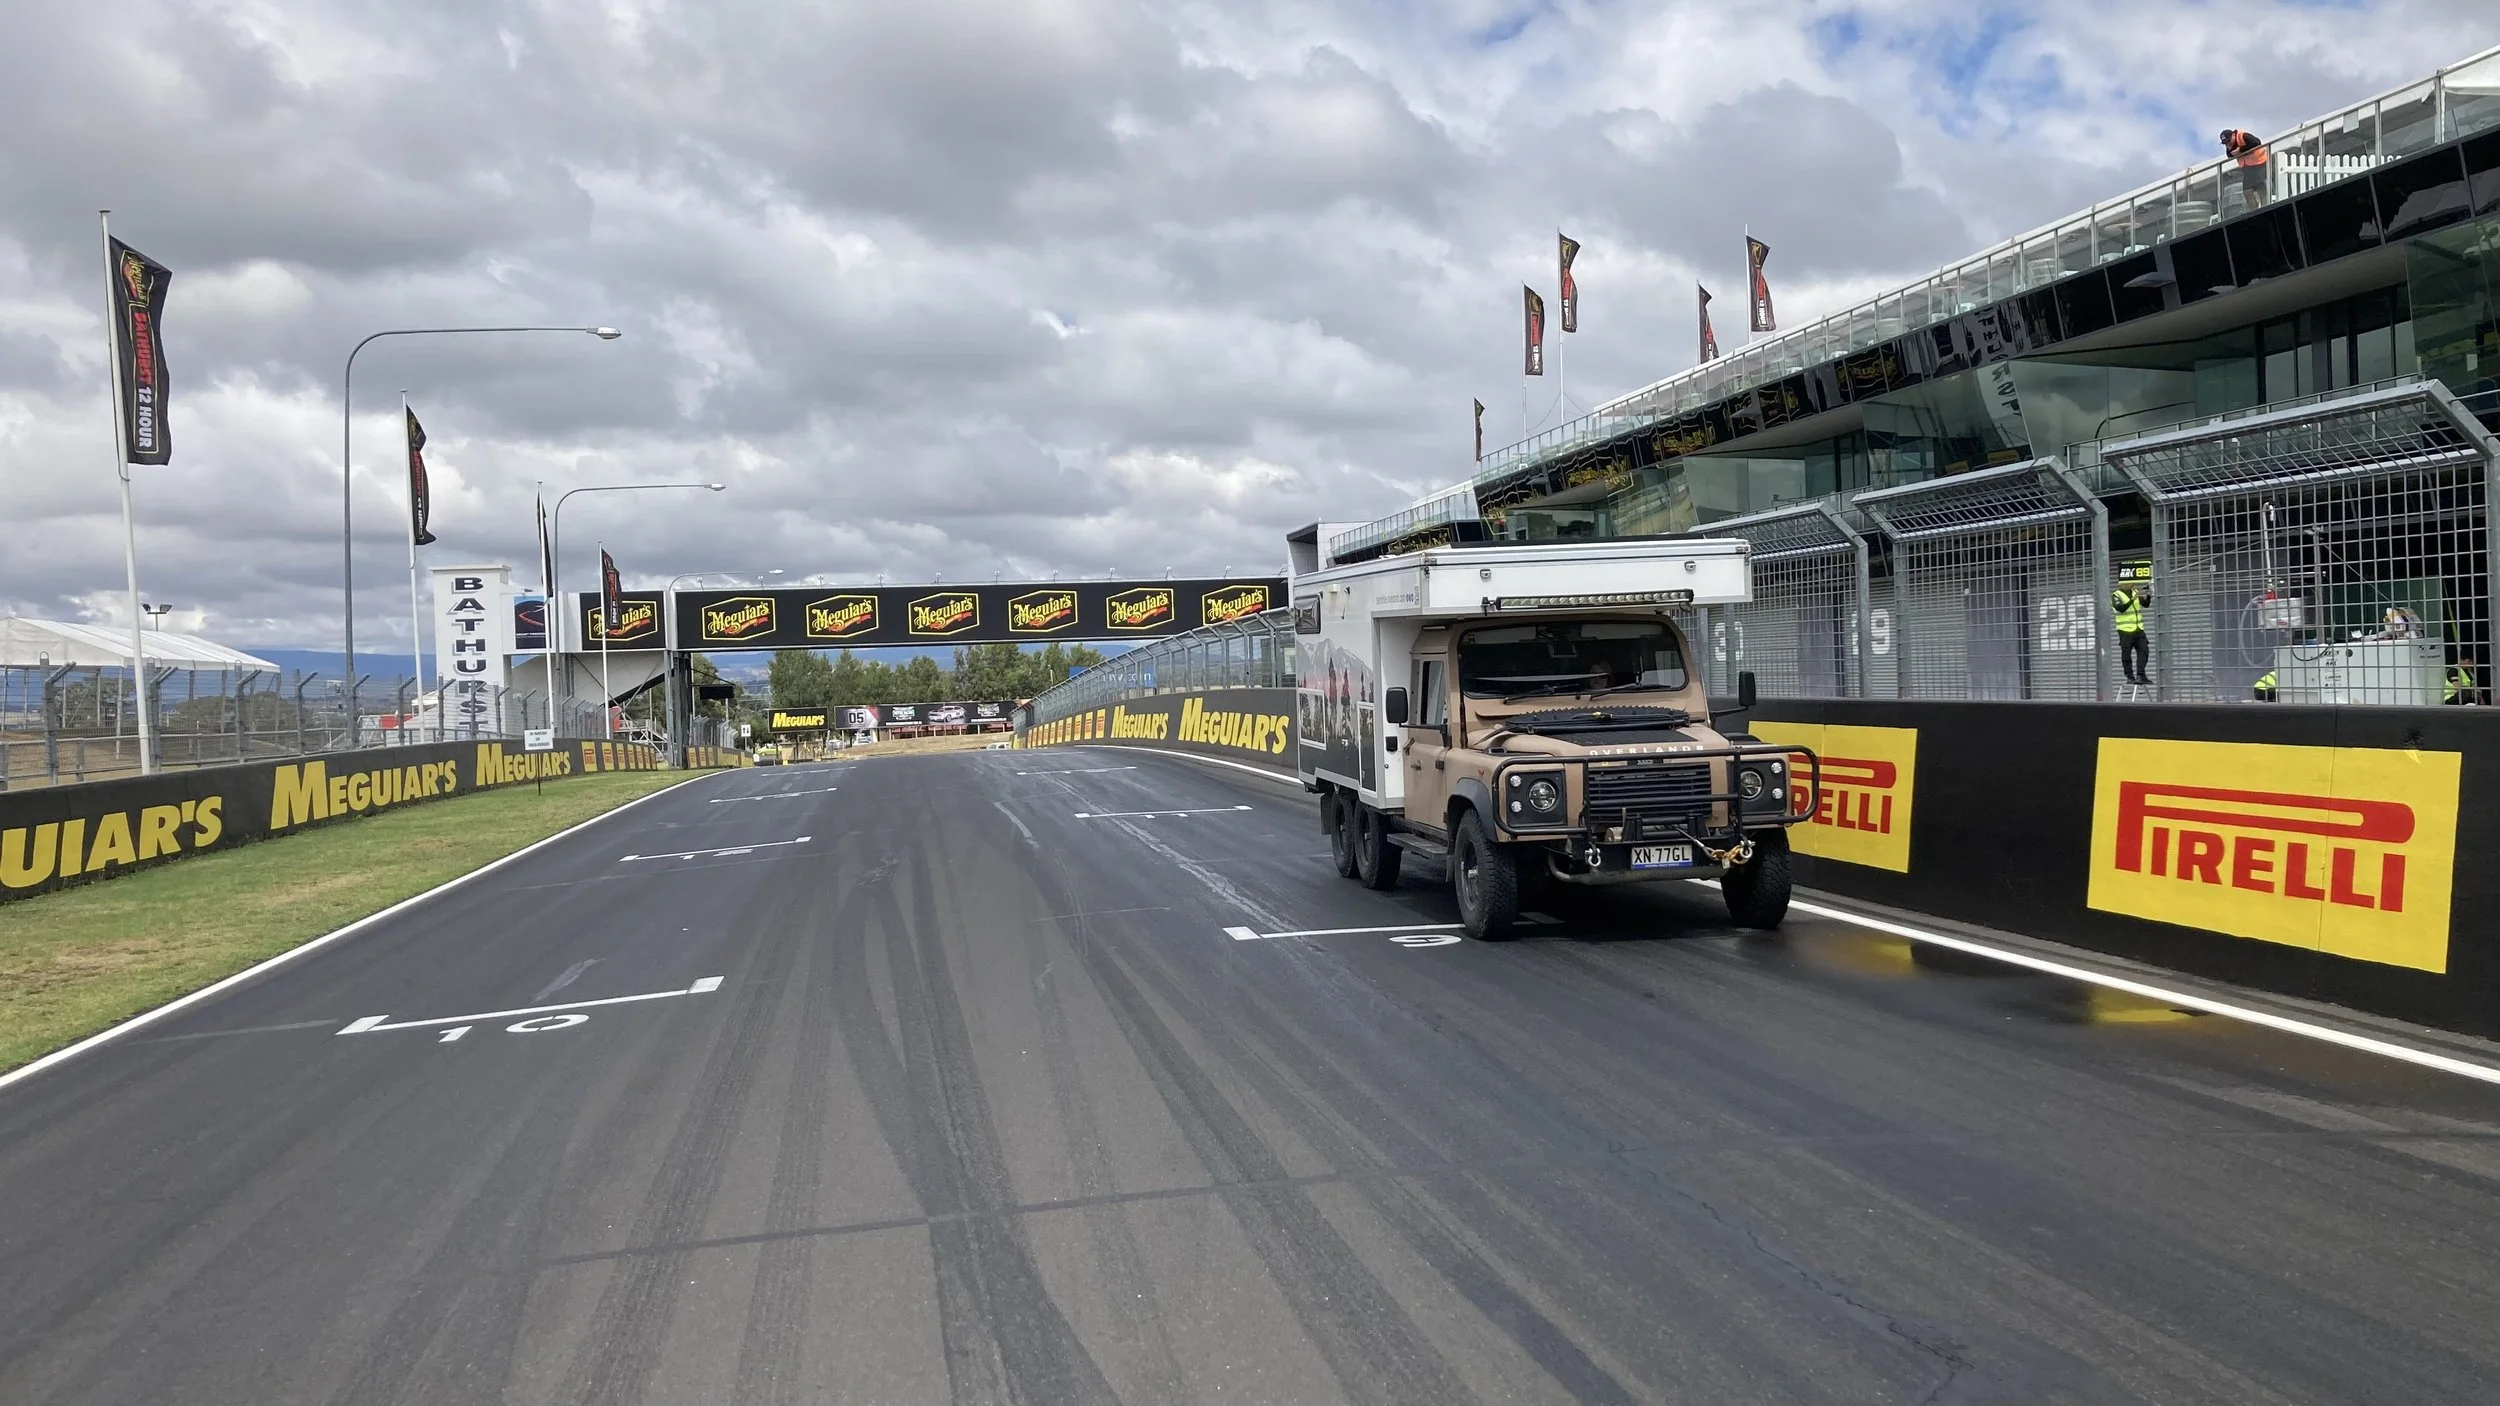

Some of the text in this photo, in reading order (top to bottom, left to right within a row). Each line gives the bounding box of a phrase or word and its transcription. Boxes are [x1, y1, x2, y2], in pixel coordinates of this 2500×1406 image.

[138, 386, 152, 404] 12
[138, 406, 153, 448] HOUR
[2136, 567, 2150, 577] 89
[707, 601, 770, 635] Meguiar's
[812, 599, 873, 632] Meguiar's
[913, 596, 974, 629] Meguiar's
[1013, 594, 1072, 627] Meguiar's
[1111, 591, 1169, 624] Meguiar's
[1207, 588, 1263, 621] Meguiar's
[2040, 595, 2096, 650] 28
[772, 712, 825, 728] MEGUIAR'S
[849, 712, 864, 724] 05
[1110, 705, 1169, 740] MEGUIAR'S
[1177, 697, 1290, 754] MEGUIAR'S
[476, 743, 571, 786] MEGUIAR'S
[270, 760, 457, 830] MEGUIAR'S
[1634, 847, 1690, 863] XN 77GL
[2115, 781, 2415, 913] PIRELLI
[438, 1014, 590, 1043] 10
